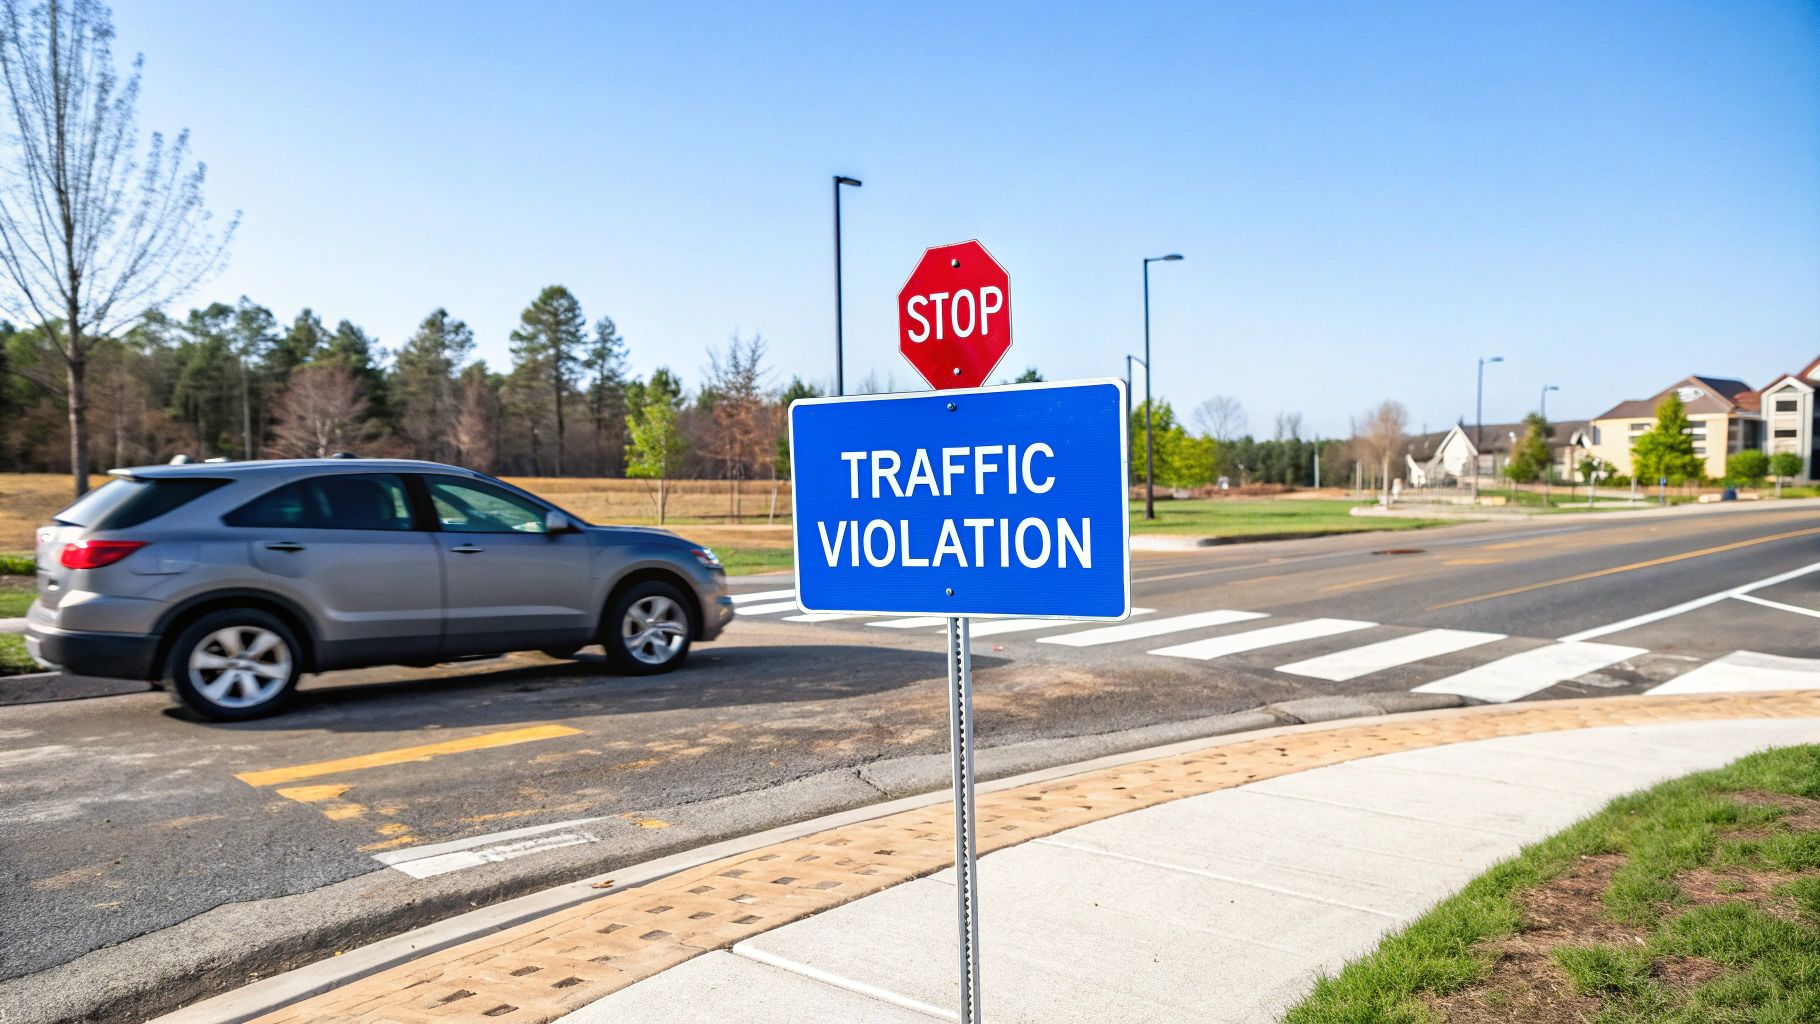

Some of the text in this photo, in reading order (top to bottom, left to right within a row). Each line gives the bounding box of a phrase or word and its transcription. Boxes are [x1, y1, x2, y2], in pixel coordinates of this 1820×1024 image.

[906, 285, 1004, 343] STOP
[840, 442, 1056, 499] TRAFFIC
[817, 517, 1093, 569] VIOLATION
